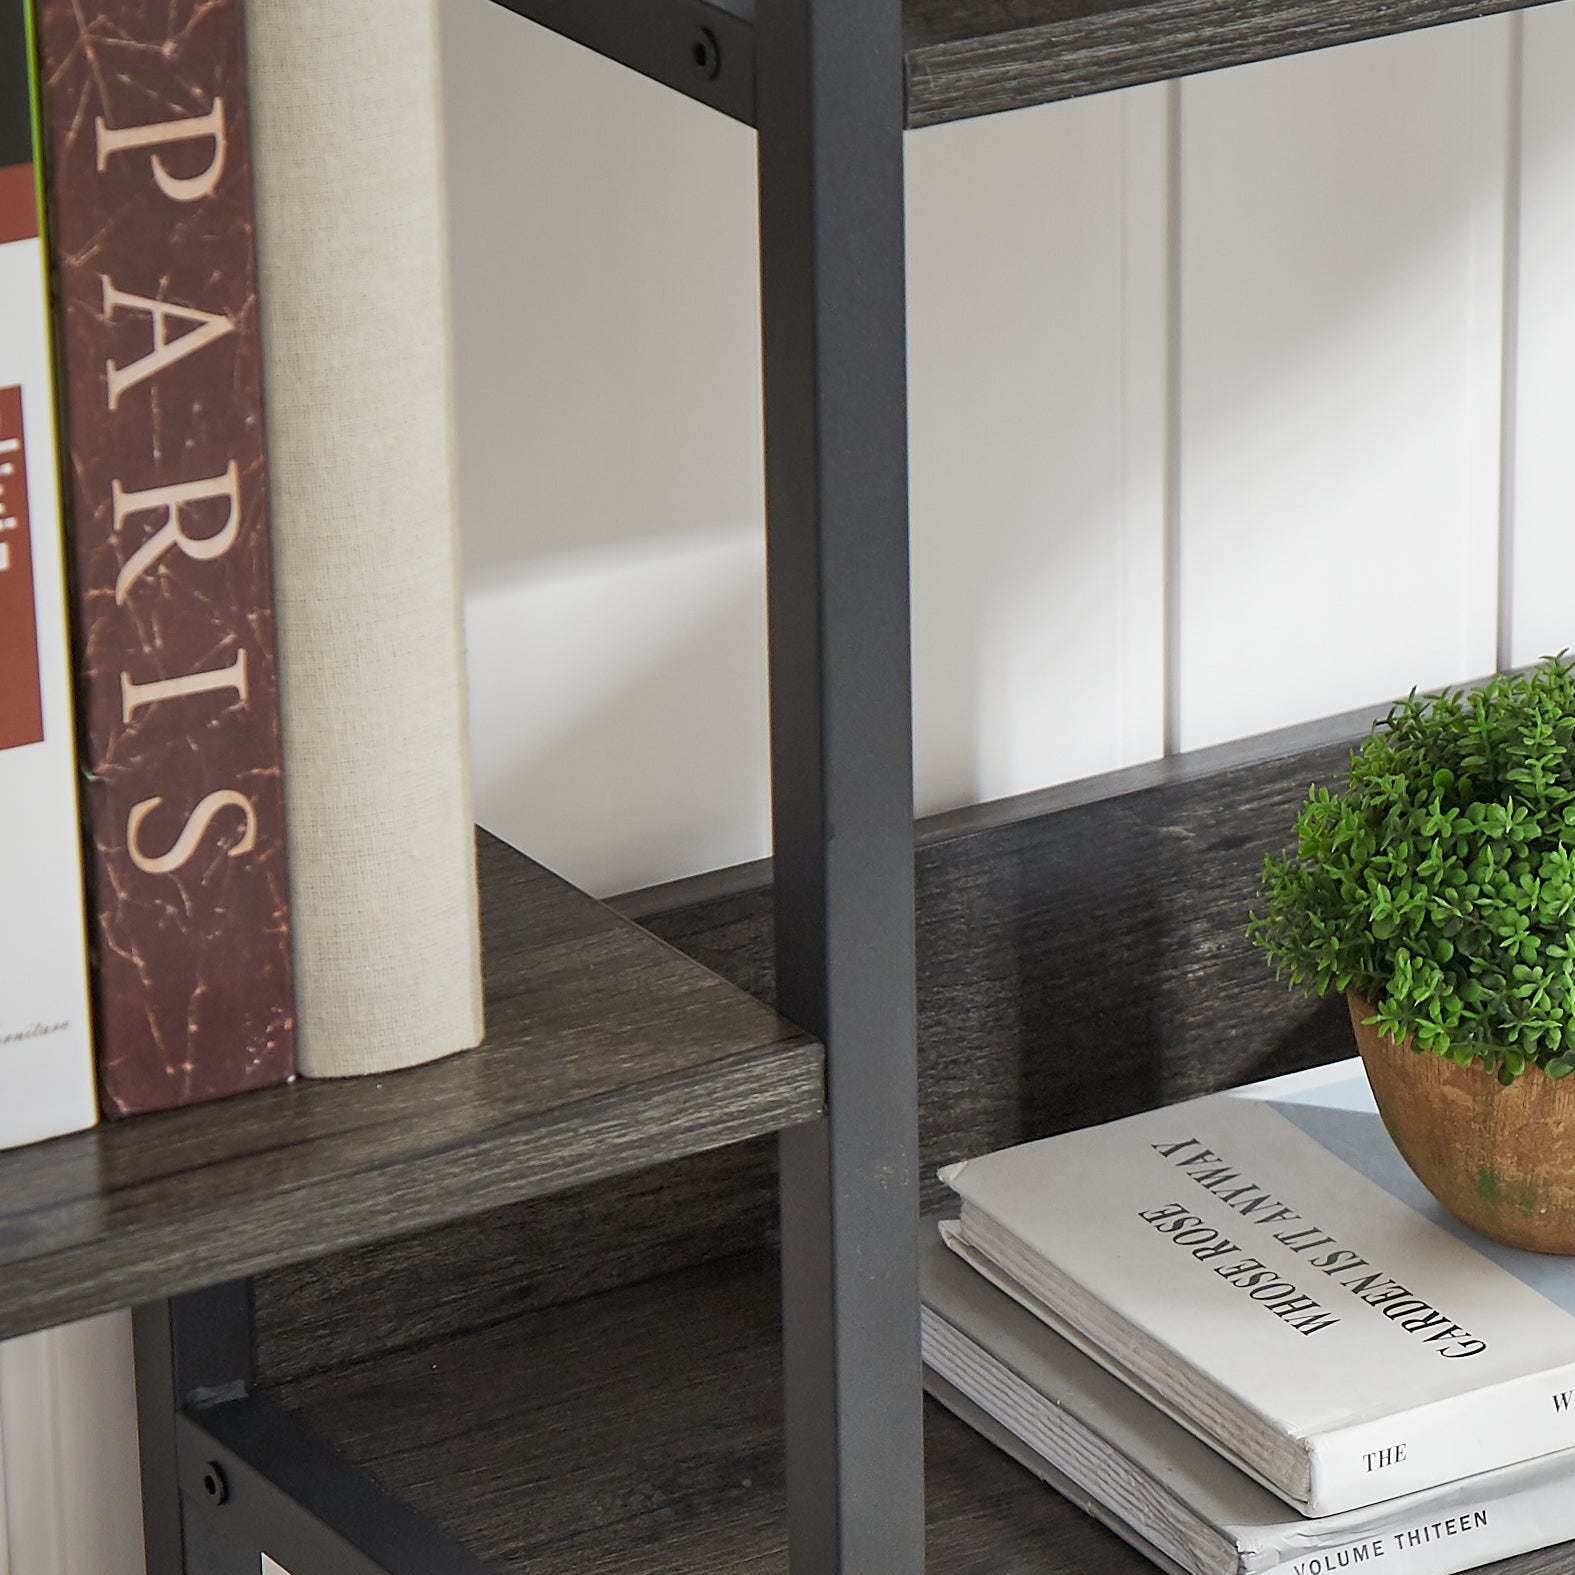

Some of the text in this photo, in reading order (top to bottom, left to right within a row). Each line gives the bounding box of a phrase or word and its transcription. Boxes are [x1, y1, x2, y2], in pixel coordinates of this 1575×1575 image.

[95, 97, 257, 873] PARIS
[1138, 1203, 1342, 1336] WHOSE ROSE
[1151, 1137, 1487, 1359] GARDEN IS IT ANYWAY
[1363, 1443, 1407, 1472] THE
[1395, 1510, 1488, 1551] THITEEN
